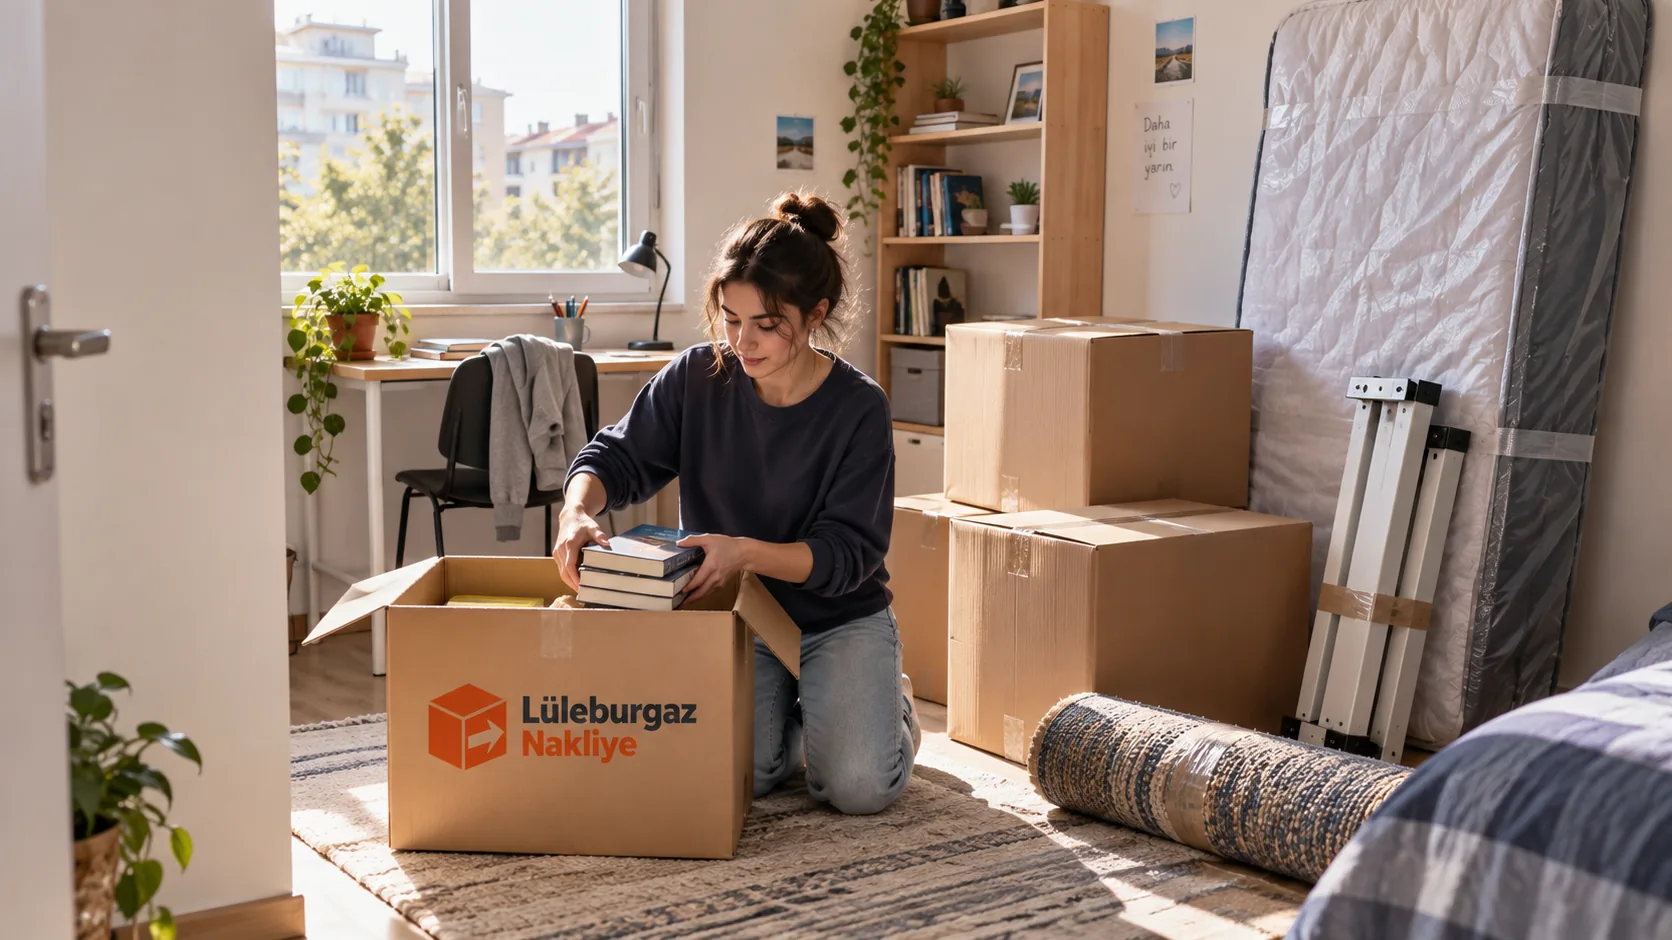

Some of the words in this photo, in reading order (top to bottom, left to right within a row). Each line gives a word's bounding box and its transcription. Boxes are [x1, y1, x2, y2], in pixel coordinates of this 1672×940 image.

[1143, 115, 1171, 132] Daha
[1144, 139, 1156, 158] iyi
[1162, 137, 1177, 151] bir
[522, 696, 697, 731] Lüleburgaz
[522, 729, 637, 763] Nakliye
